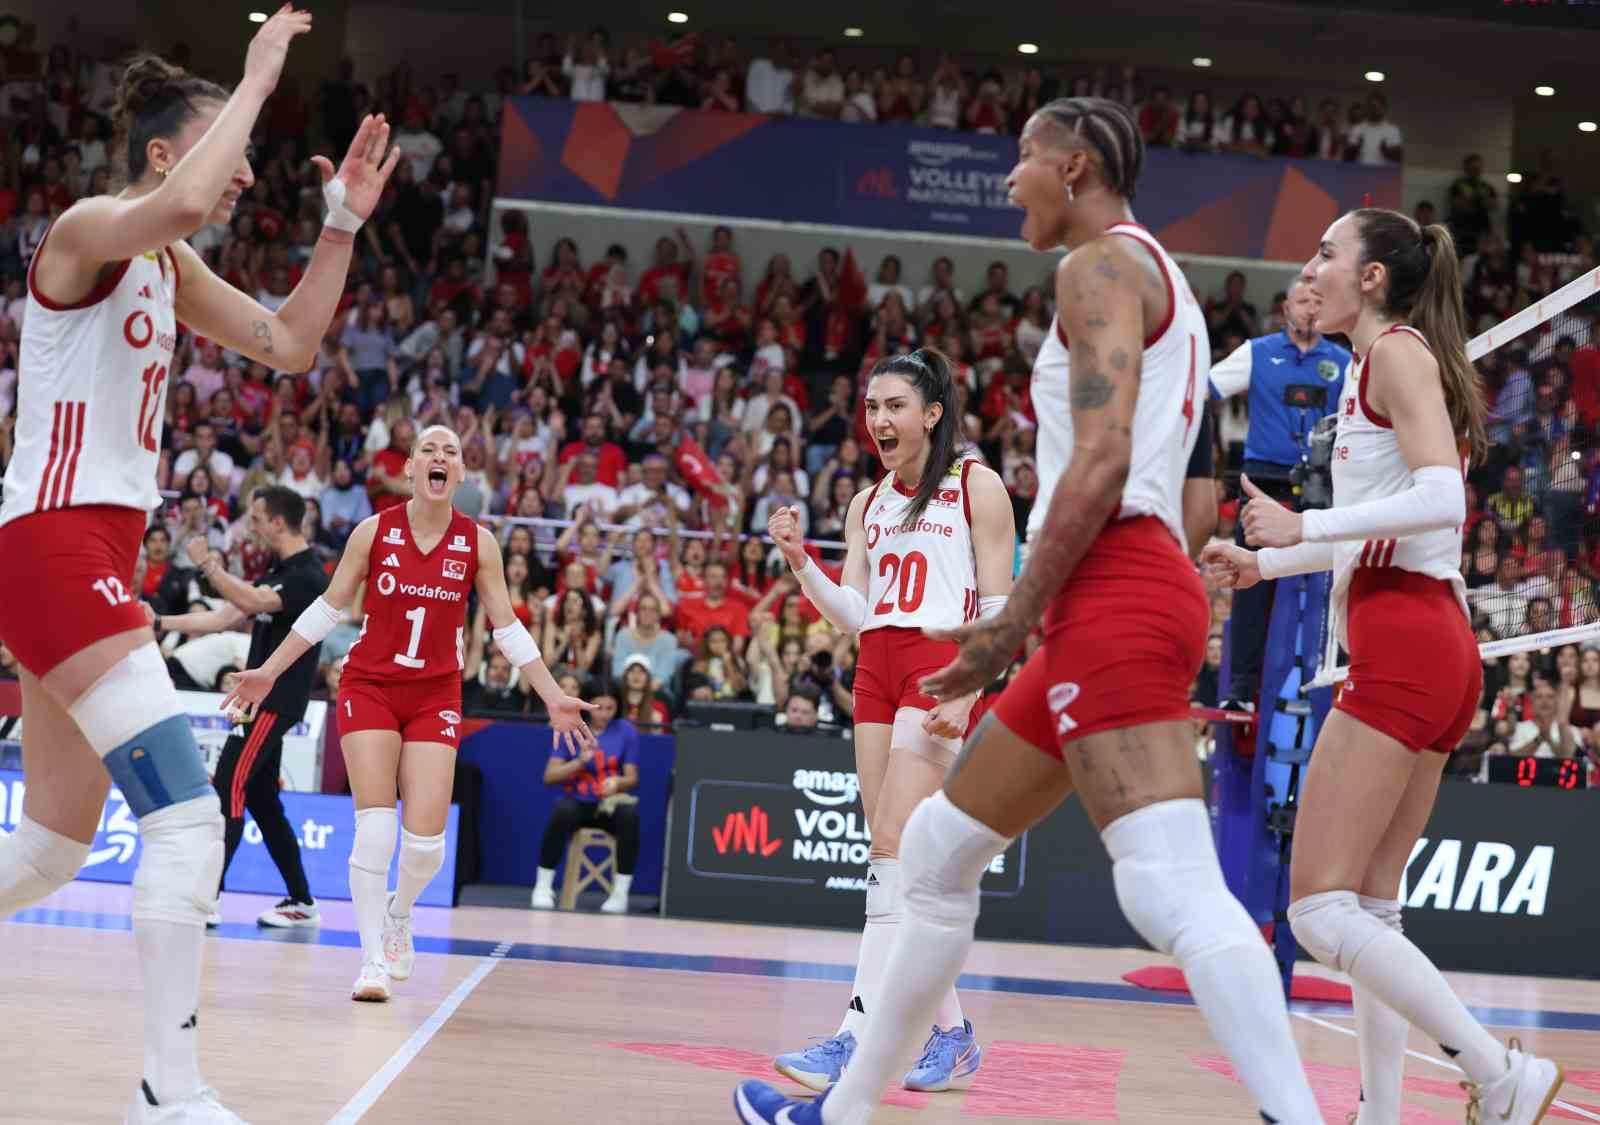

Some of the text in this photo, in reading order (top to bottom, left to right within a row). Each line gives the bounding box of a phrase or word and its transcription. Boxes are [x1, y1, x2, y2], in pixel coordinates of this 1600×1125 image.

[138, 361, 166, 453] 12
[92, 576, 131, 606] 12
[400, 584, 462, 602] vodafone
[874, 551, 928, 615] 20
[394, 606, 426, 669] 1
[344, 699, 353, 717] 1
[1517, 757, 1537, 787] 0
